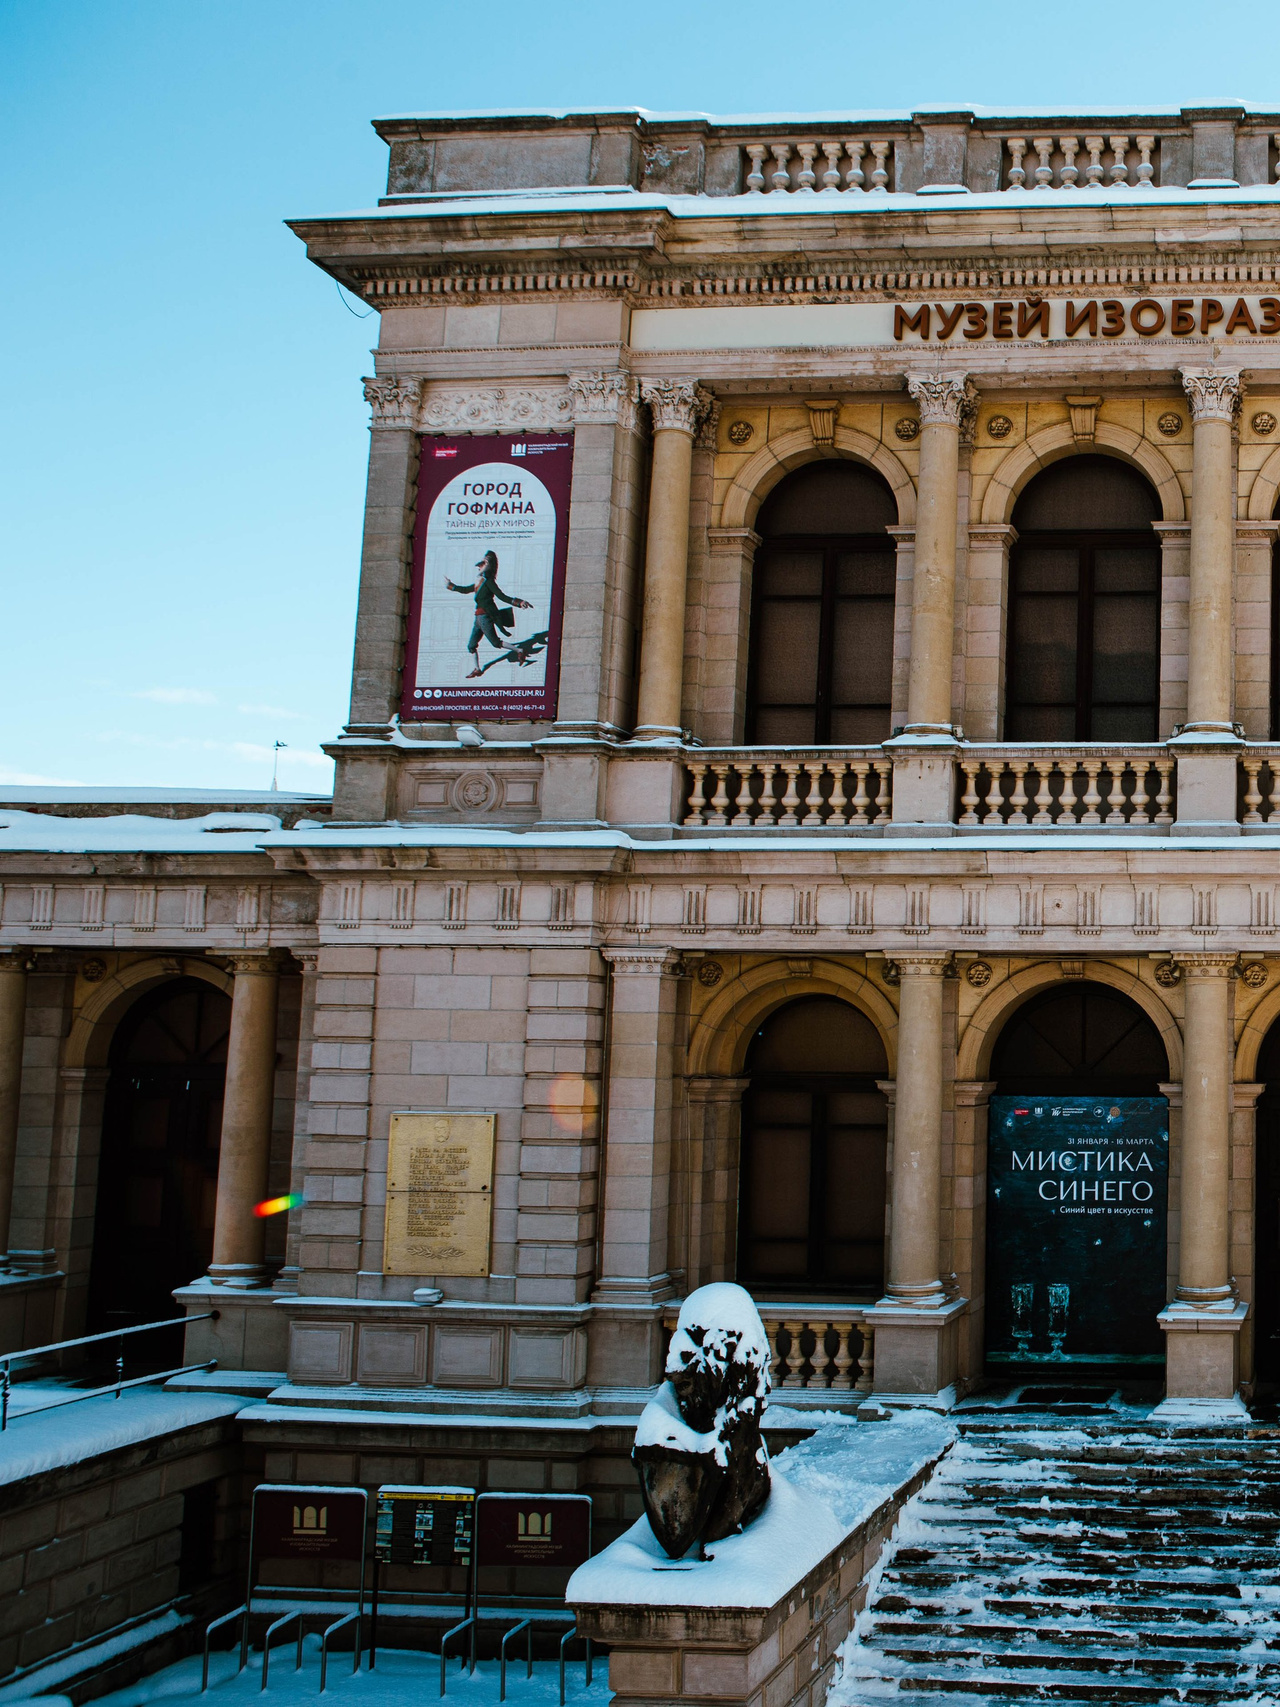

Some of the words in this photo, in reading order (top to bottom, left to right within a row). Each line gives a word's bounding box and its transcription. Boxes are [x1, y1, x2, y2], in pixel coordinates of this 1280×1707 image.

[893, 296, 1050, 340] МУЗЕЙ
[463, 482, 522, 499] ГОРОД
[447, 501, 536, 516] ГОФМАНА
[445, 518, 477, 529] ТАЙНЫ
[478, 519, 501, 530] ДВУХ
[503, 519, 536, 528] МИРОВ
[443, 689, 545, 698] KALININGRADARTMUSEUM.RU
[1012, 1150, 1154, 1172] МИСТИКА
[1038, 1180, 1154, 1202] СИНЕГО
[1059, 1205, 1085, 1214] Синий
[1087, 1207, 1106, 1215] цвет
[1114, 1207, 1154, 1216] искусстве
